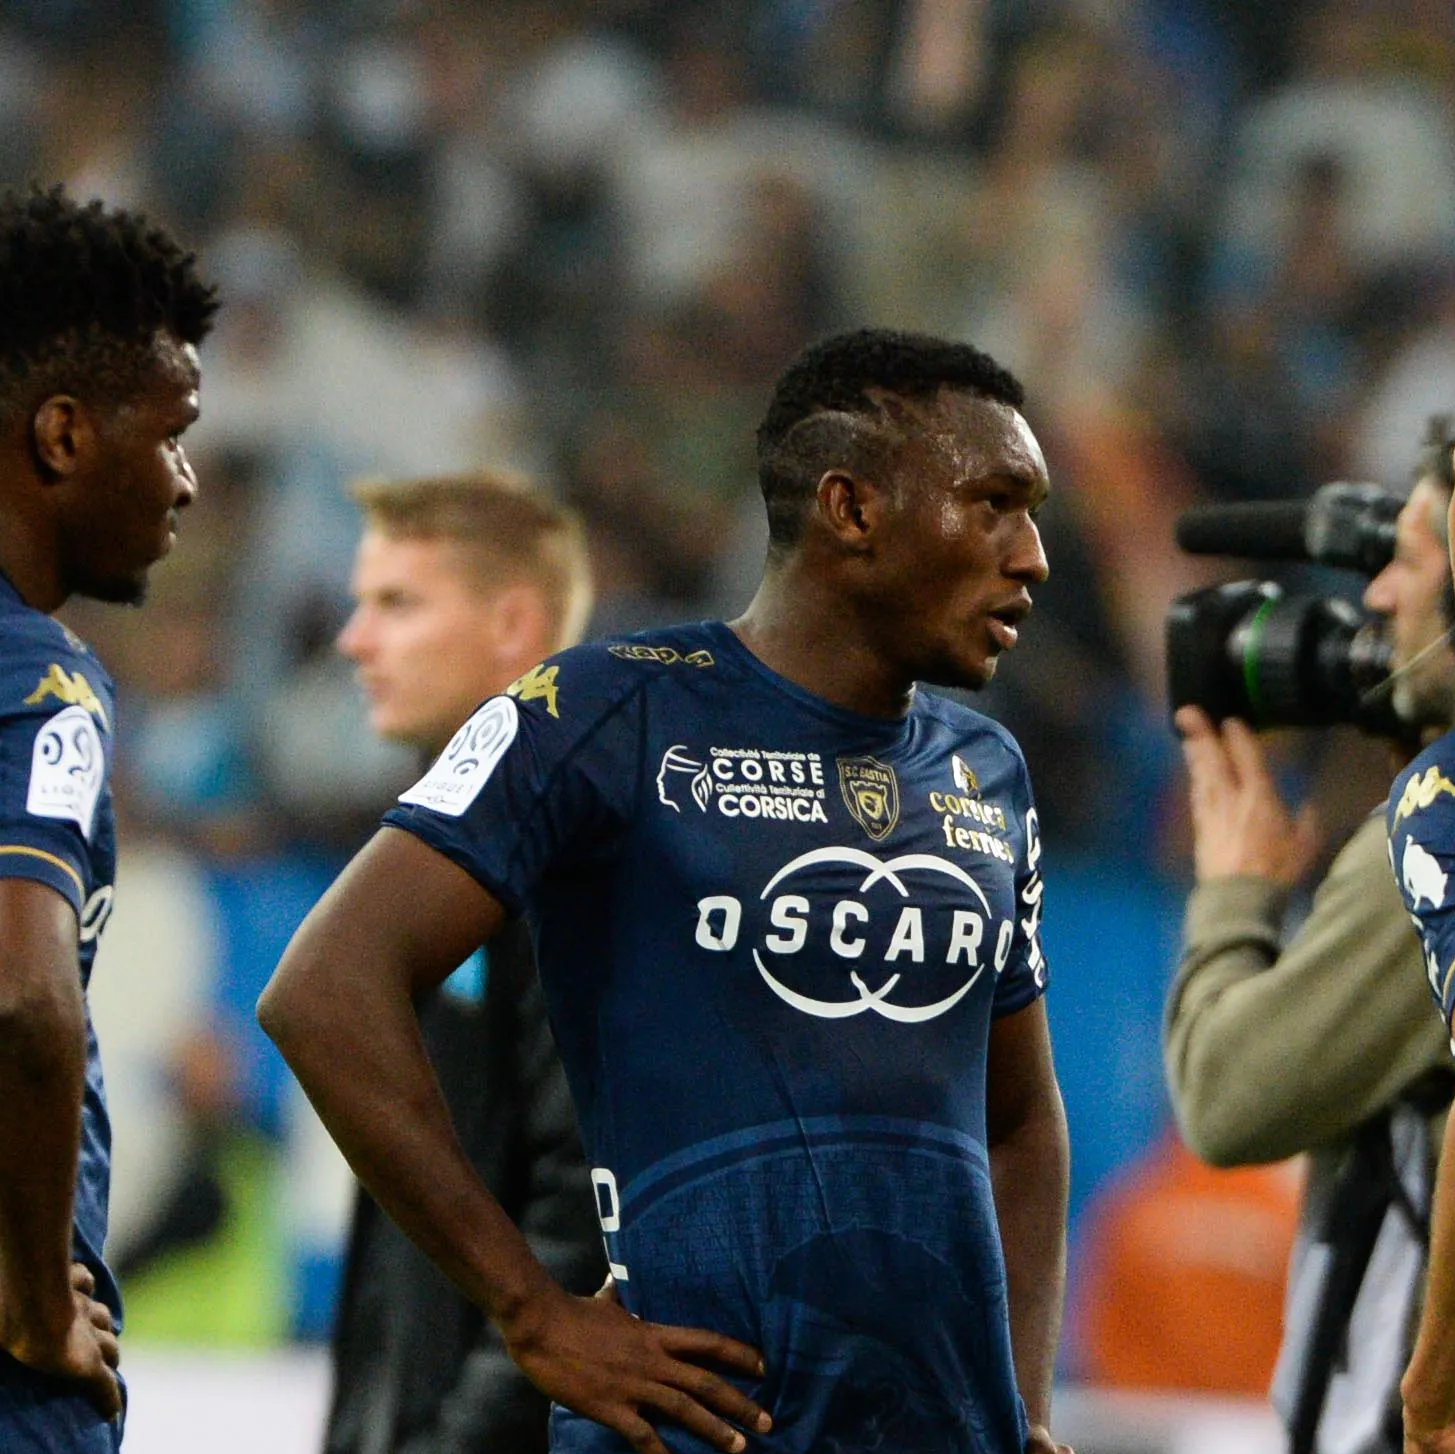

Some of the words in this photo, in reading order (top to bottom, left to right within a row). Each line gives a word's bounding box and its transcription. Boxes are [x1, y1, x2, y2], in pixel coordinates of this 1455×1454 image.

[712, 757, 825, 785] CORSE
[717, 793, 829, 824] CORSICA
[694, 894, 1015, 974] OSCARO
